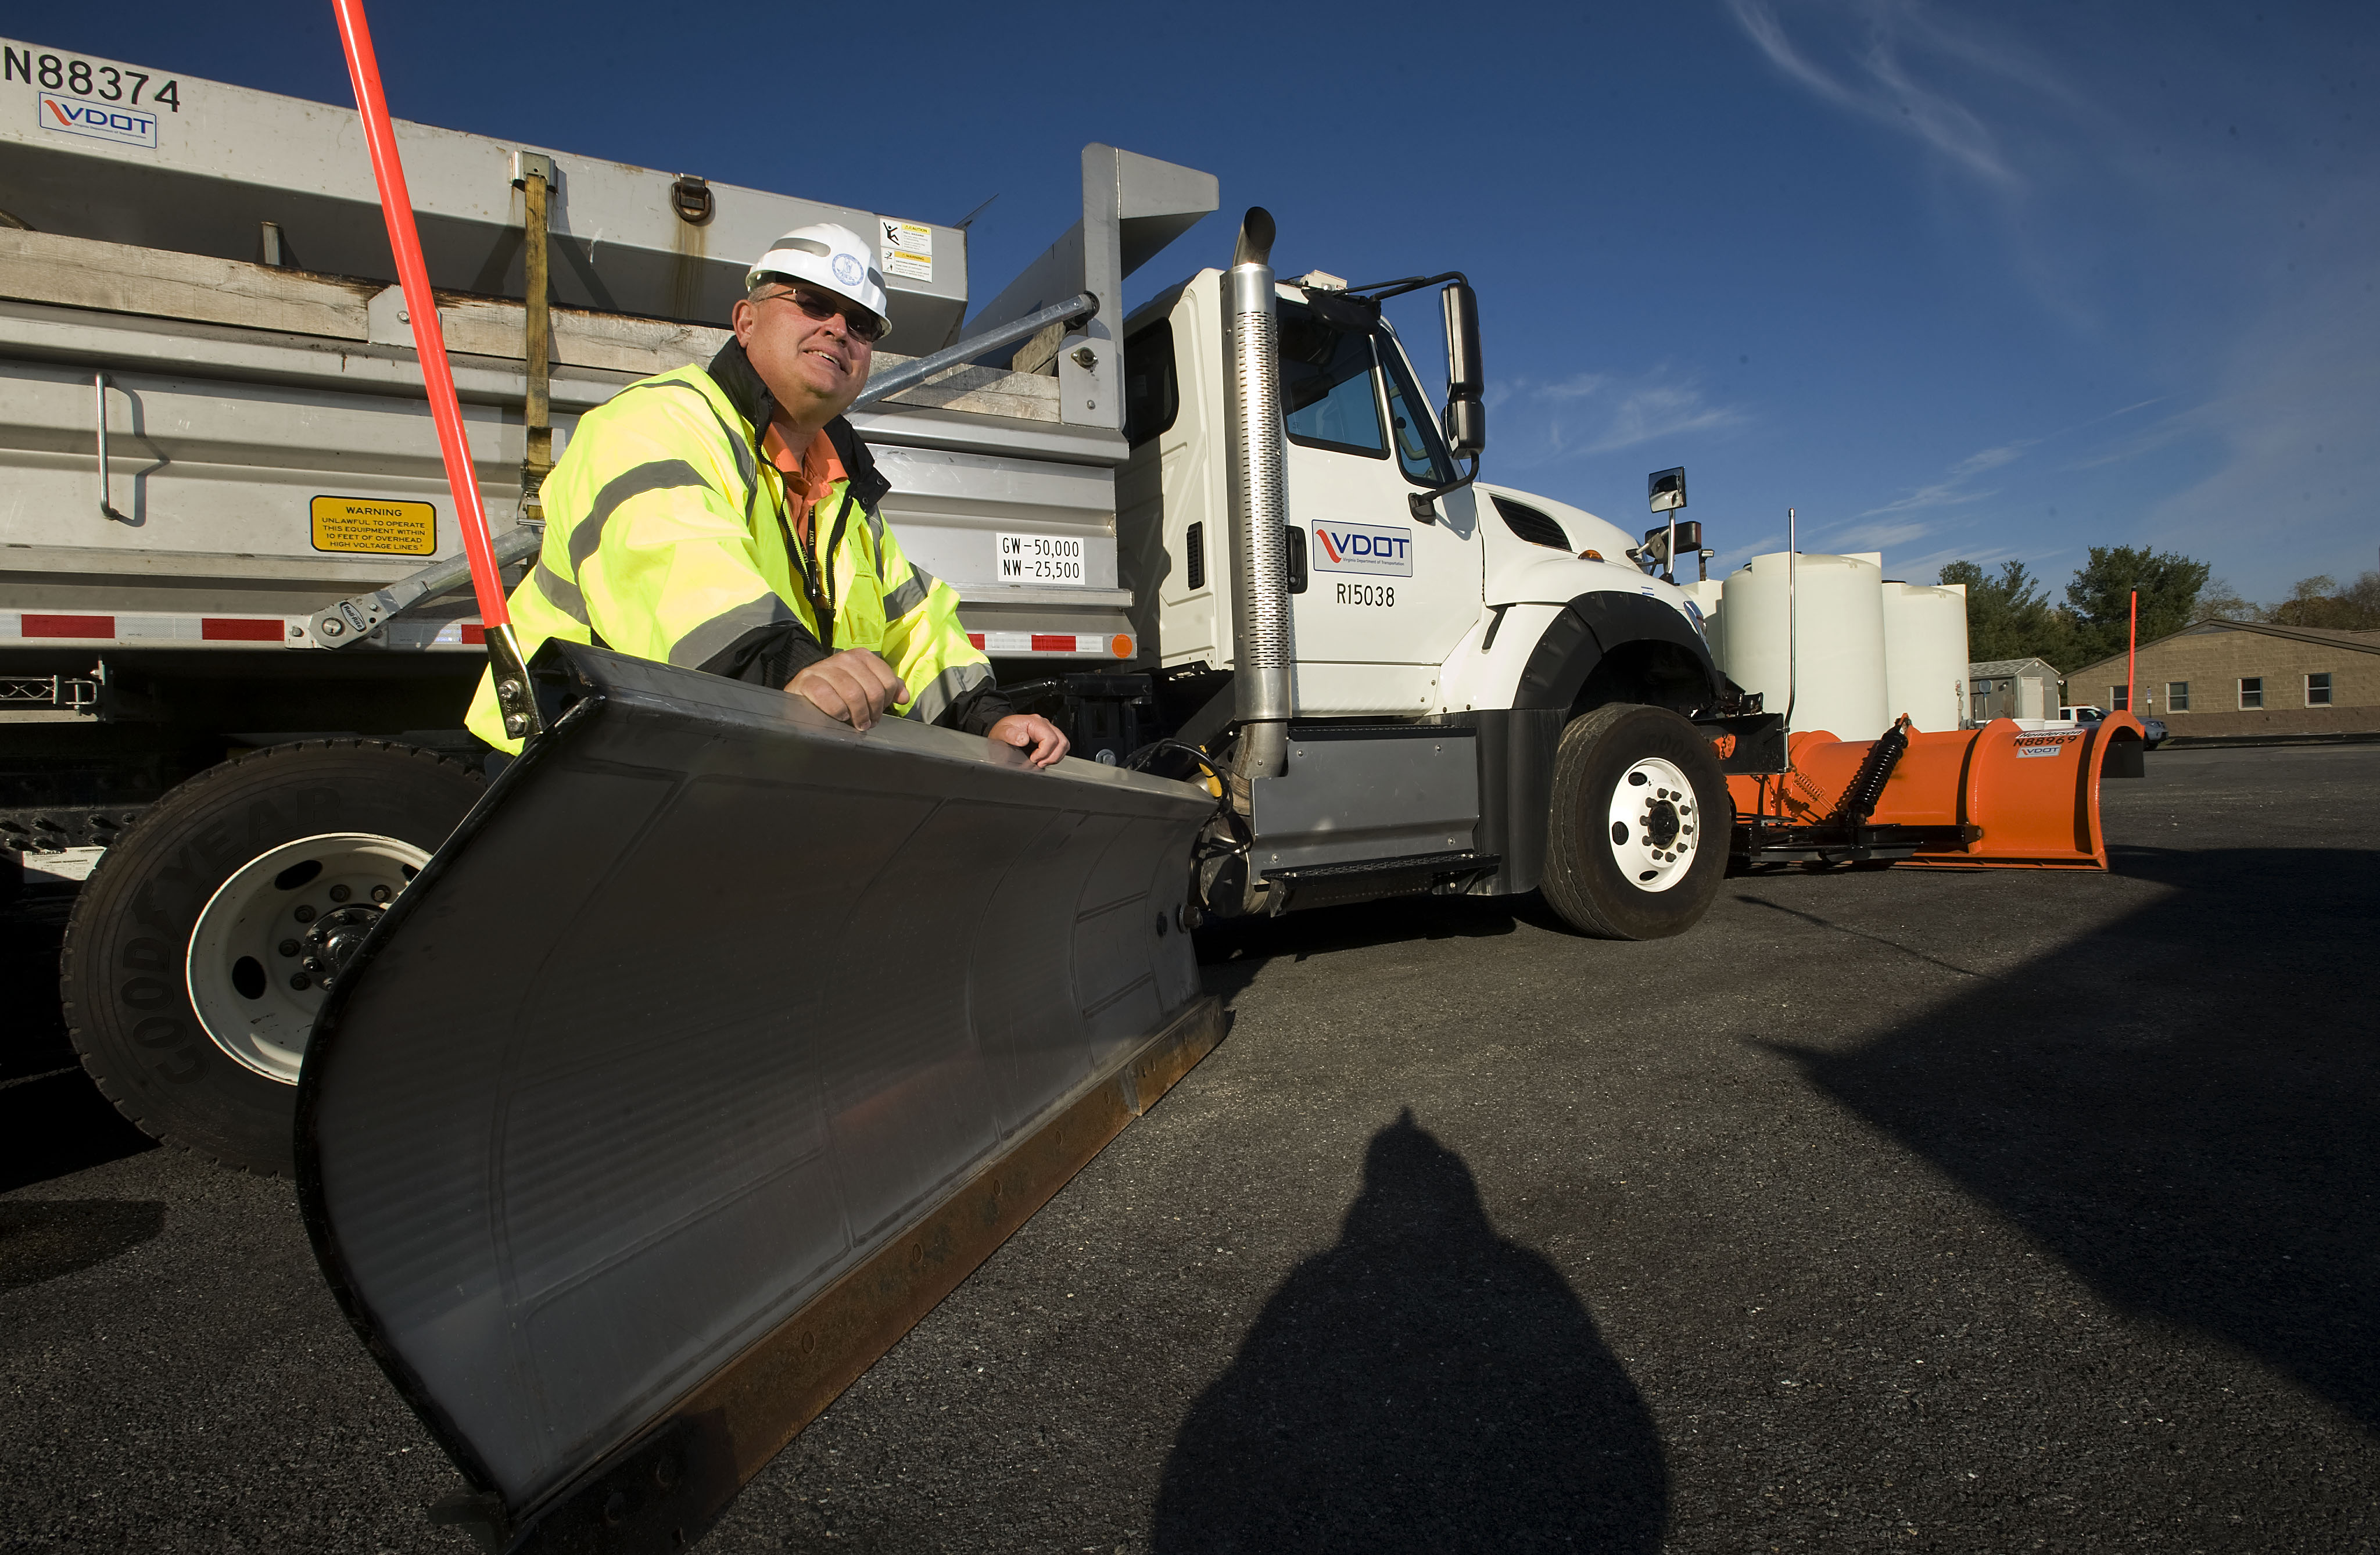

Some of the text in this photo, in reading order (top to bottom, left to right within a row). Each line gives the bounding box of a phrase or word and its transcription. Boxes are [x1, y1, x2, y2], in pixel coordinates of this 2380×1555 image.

[4, 46, 180, 113] N88374
[62, 103, 153, 134] VDOT
[909, 225, 927, 233] CAUTION
[322, 517, 370, 525] UNLAWFUL
[345, 507, 402, 517] WARNING
[1002, 537, 1079, 558] GW-50,000
[1331, 532, 1410, 558] VDOT
[1003, 559, 1080, 581] NW-25,500
[1336, 583, 1395, 607] R15038
[2013, 736, 2077, 747] N88969
[120, 786, 341, 1085] GOODYEAR
